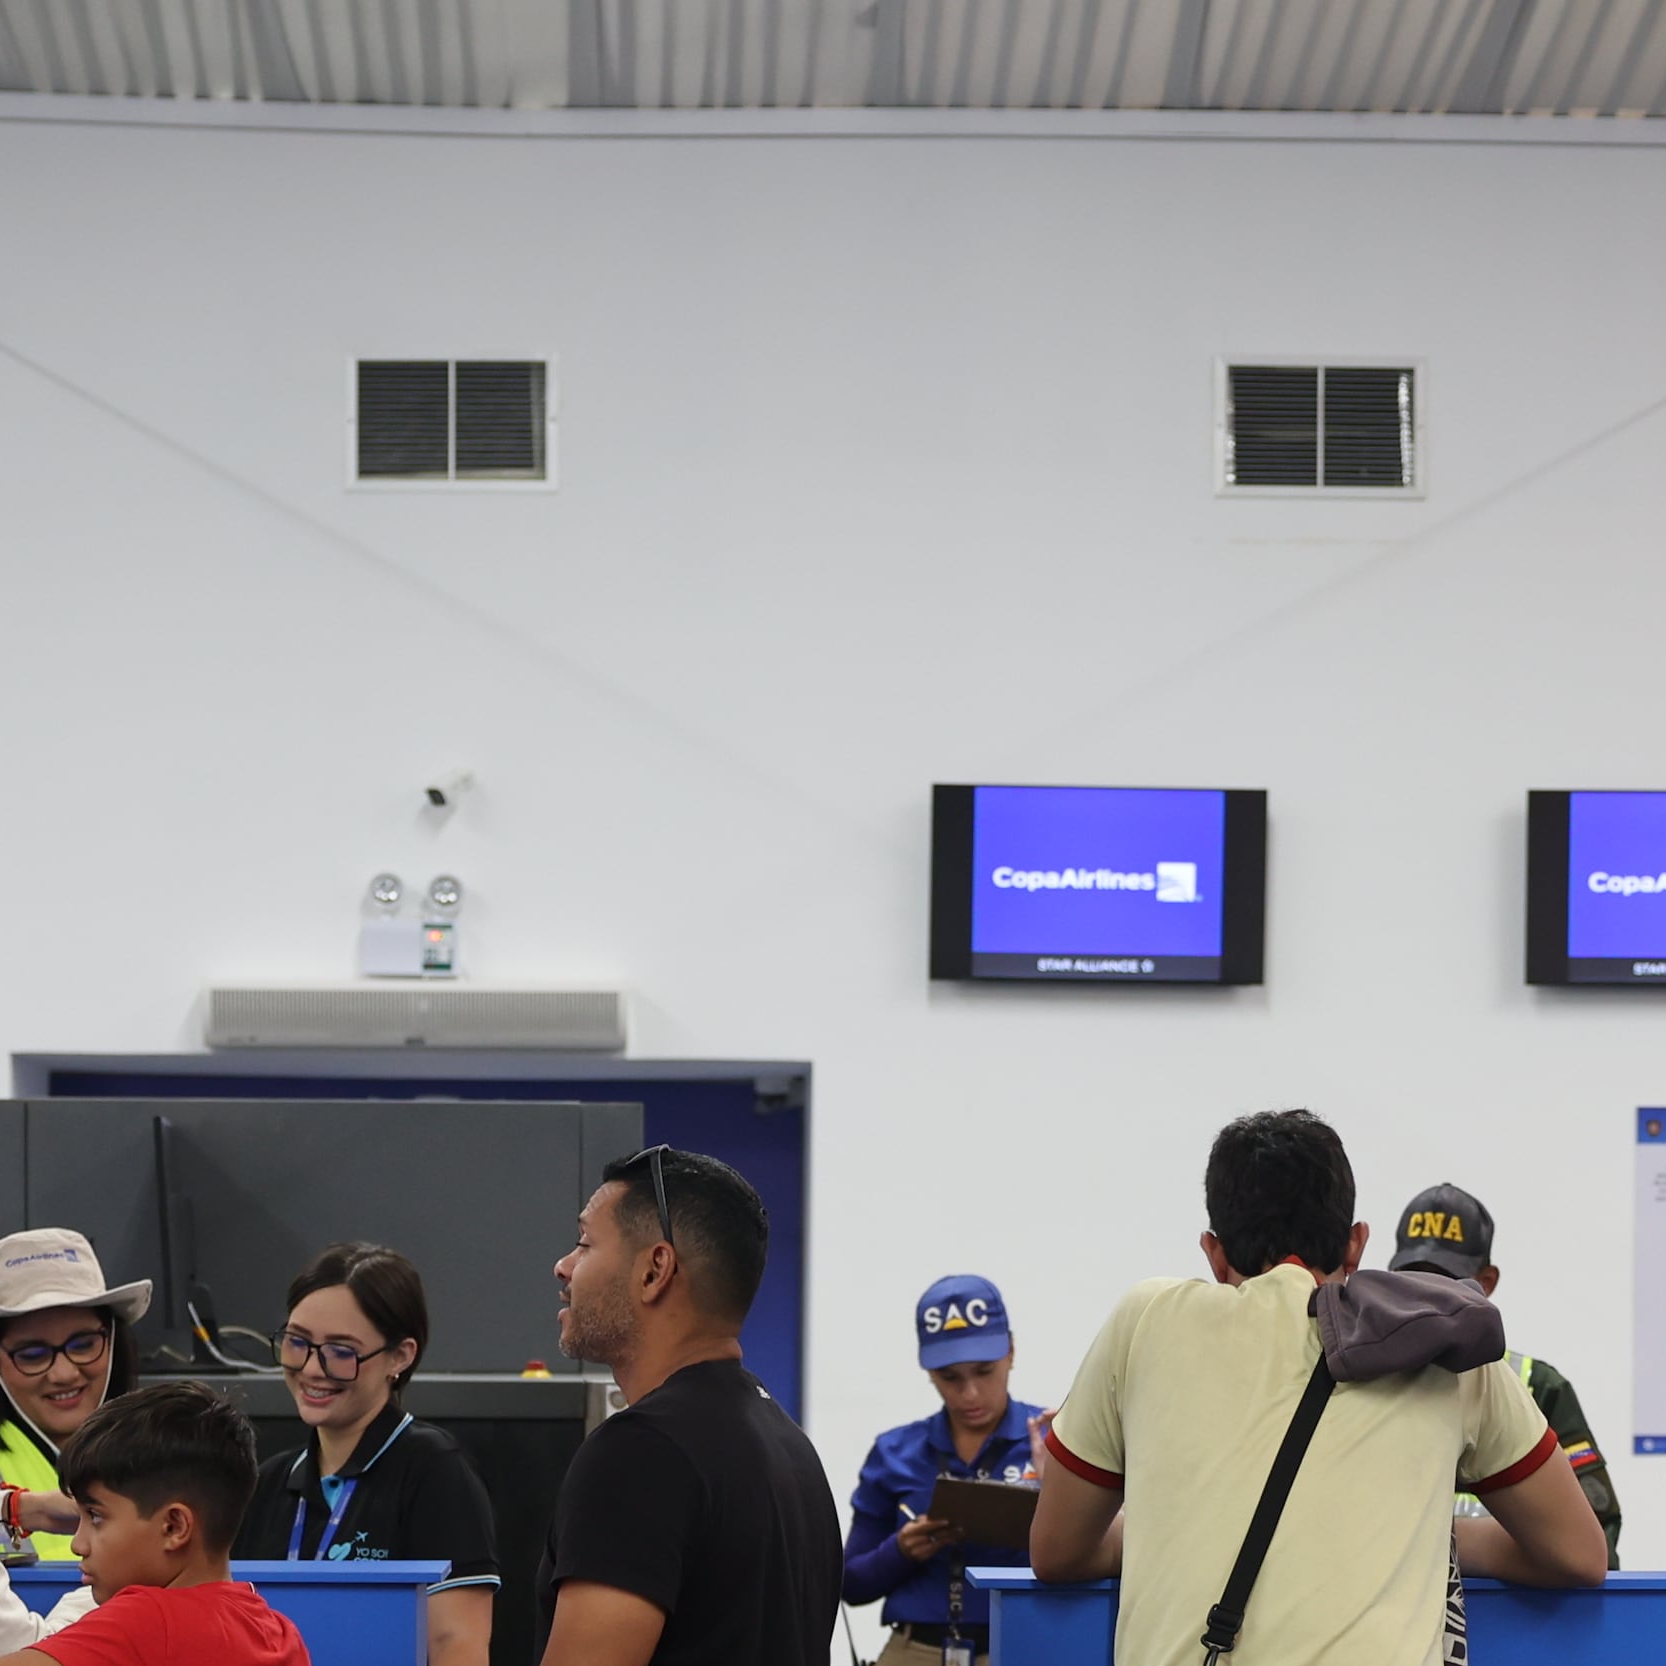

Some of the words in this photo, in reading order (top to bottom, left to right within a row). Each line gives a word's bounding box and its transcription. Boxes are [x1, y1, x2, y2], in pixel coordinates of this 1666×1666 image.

[992, 866, 1155, 892] CopaAirlines
[1408, 1211, 1463, 1242] CNA
[924, 1299, 988, 1333] SAC
